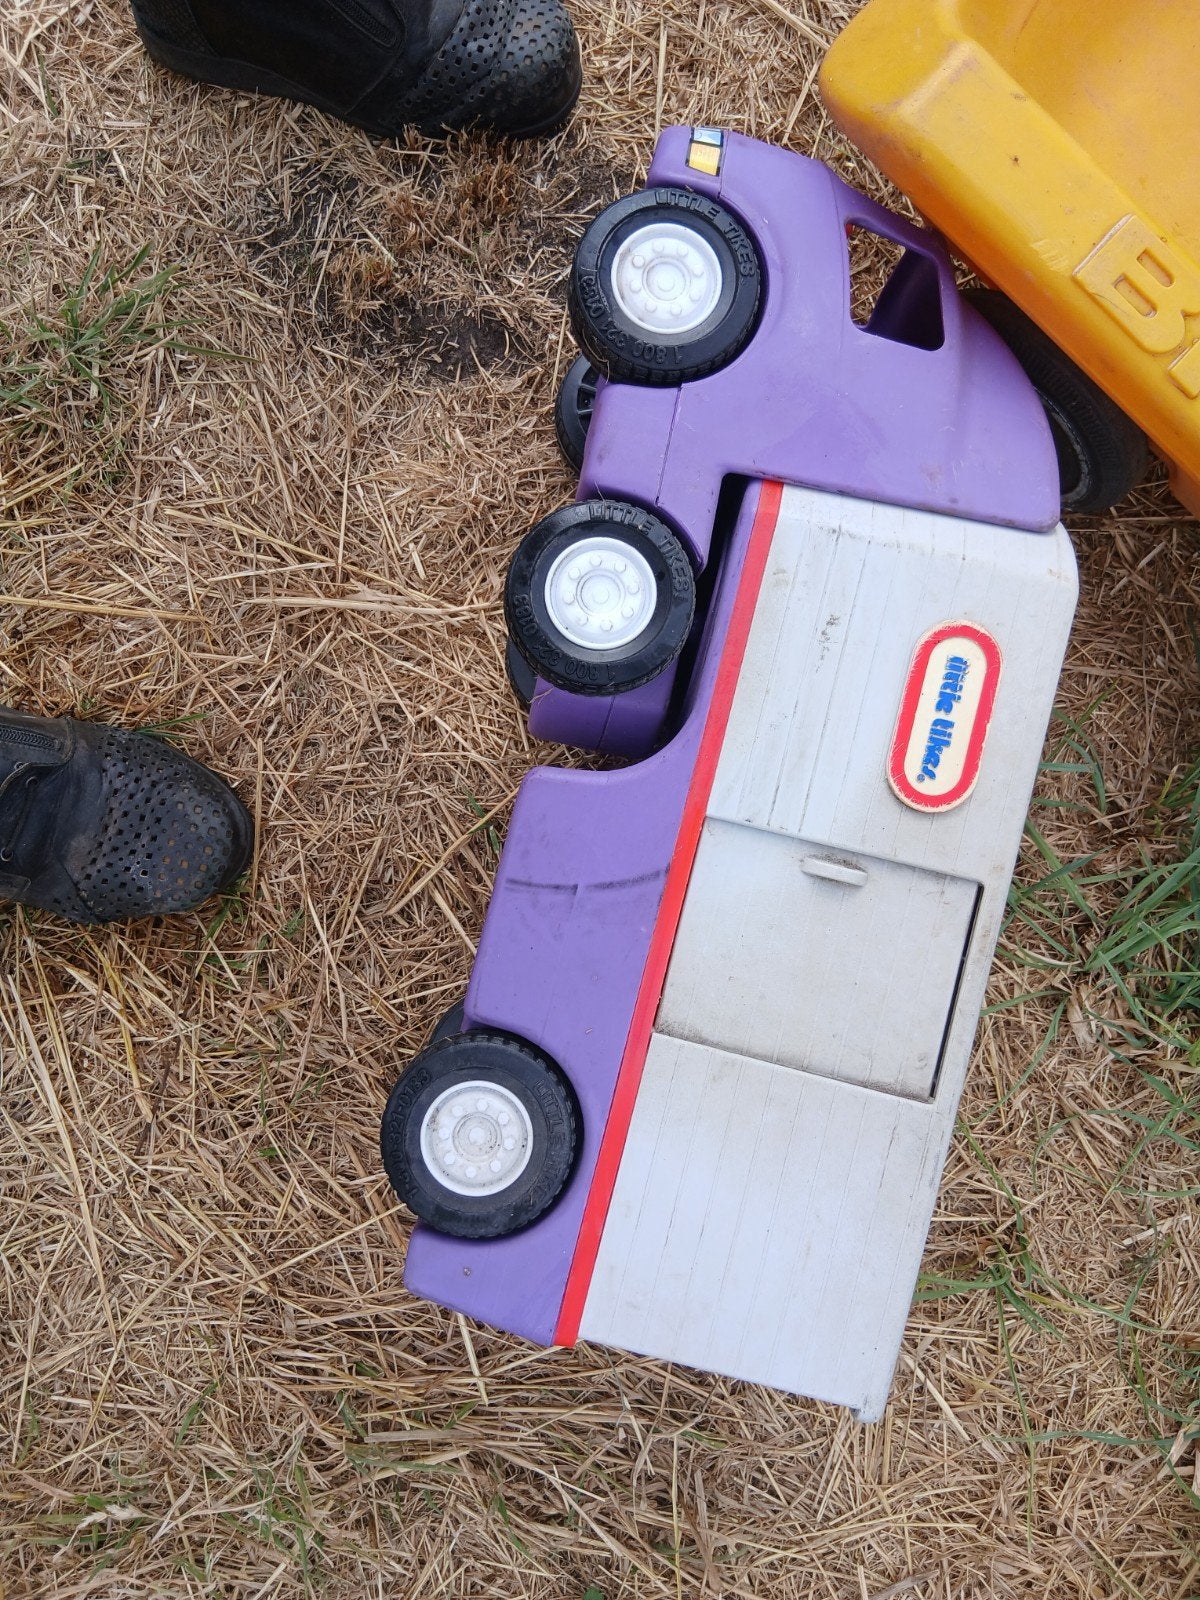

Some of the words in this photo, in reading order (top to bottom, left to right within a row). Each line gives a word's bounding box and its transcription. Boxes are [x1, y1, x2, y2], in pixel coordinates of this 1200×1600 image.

[654, 189, 720, 222] LITTLE
[722, 223, 757, 278] TIKES
[588, 504, 653, 536] LITTLE
[657, 535, 691, 592] TIKES
[934, 654, 971, 715] little
